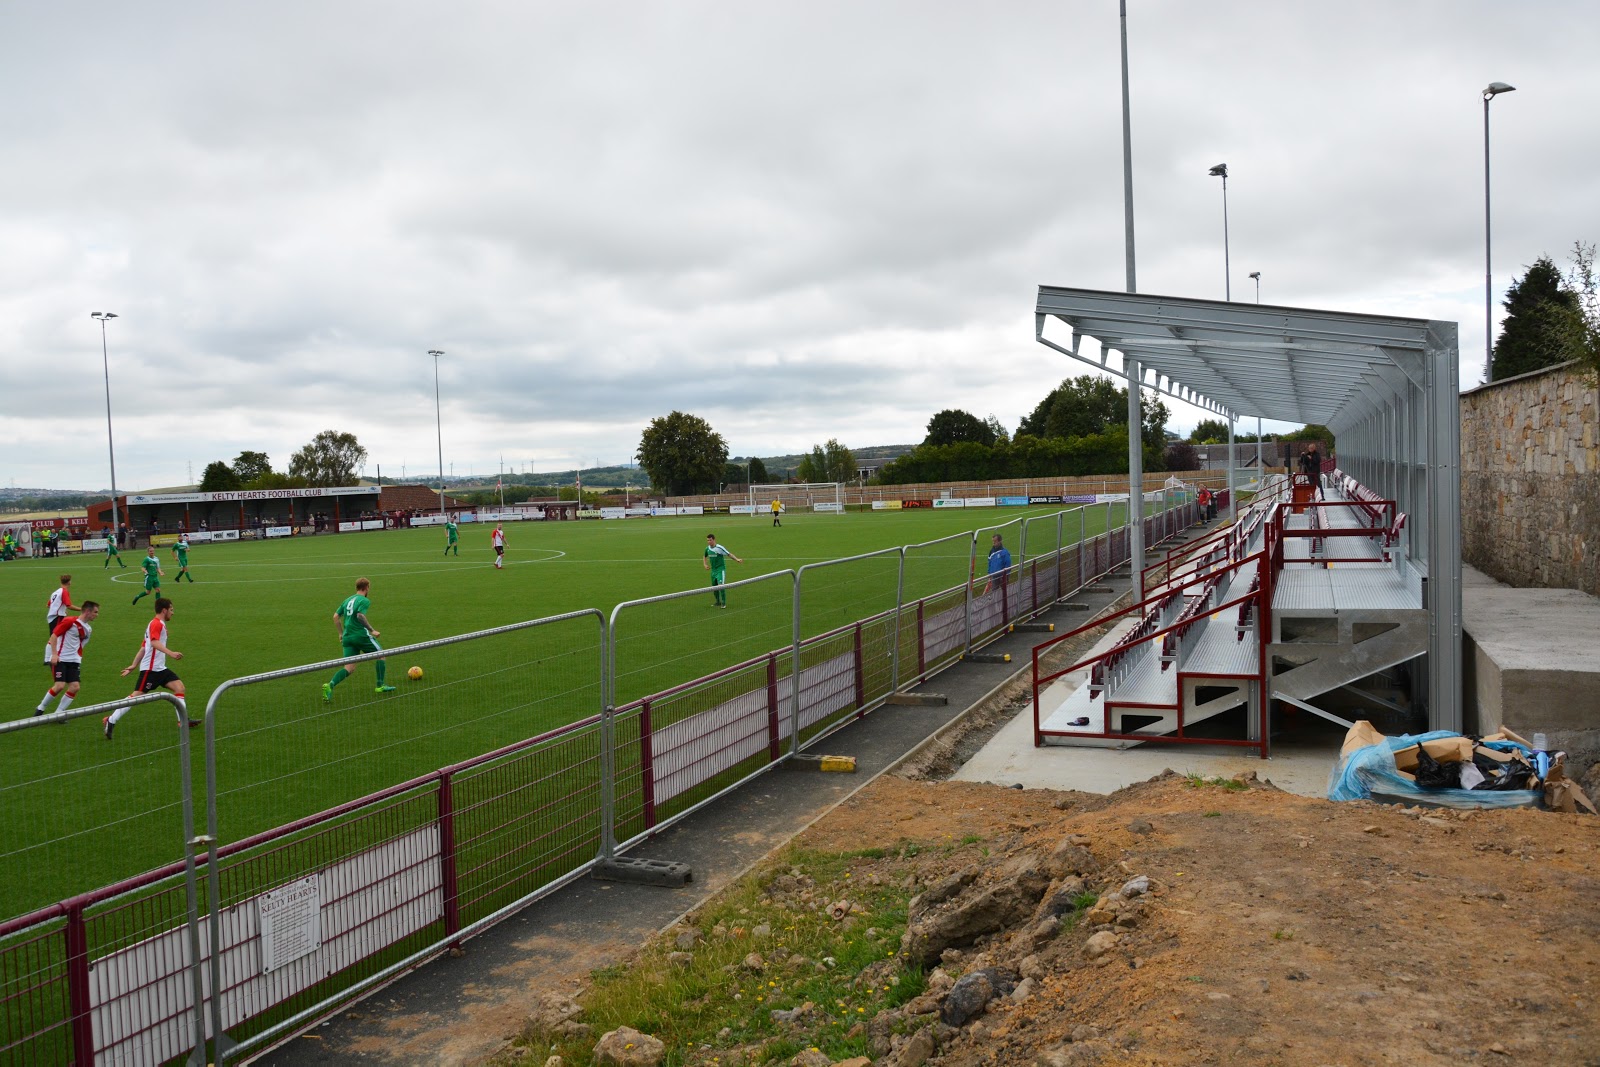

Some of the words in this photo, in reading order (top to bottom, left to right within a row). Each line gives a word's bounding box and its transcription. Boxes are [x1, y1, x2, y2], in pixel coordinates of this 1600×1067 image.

[212, 492, 235, 500] KELTY
[238, 491, 266, 500] HEARTS
[268, 490, 303, 498] FOOTBALL
[304, 488, 322, 496] CLUB
[346, 596, 357, 616] 9
[262, 898, 286, 914] KELTY
[288, 886, 317, 902] HEARTS
